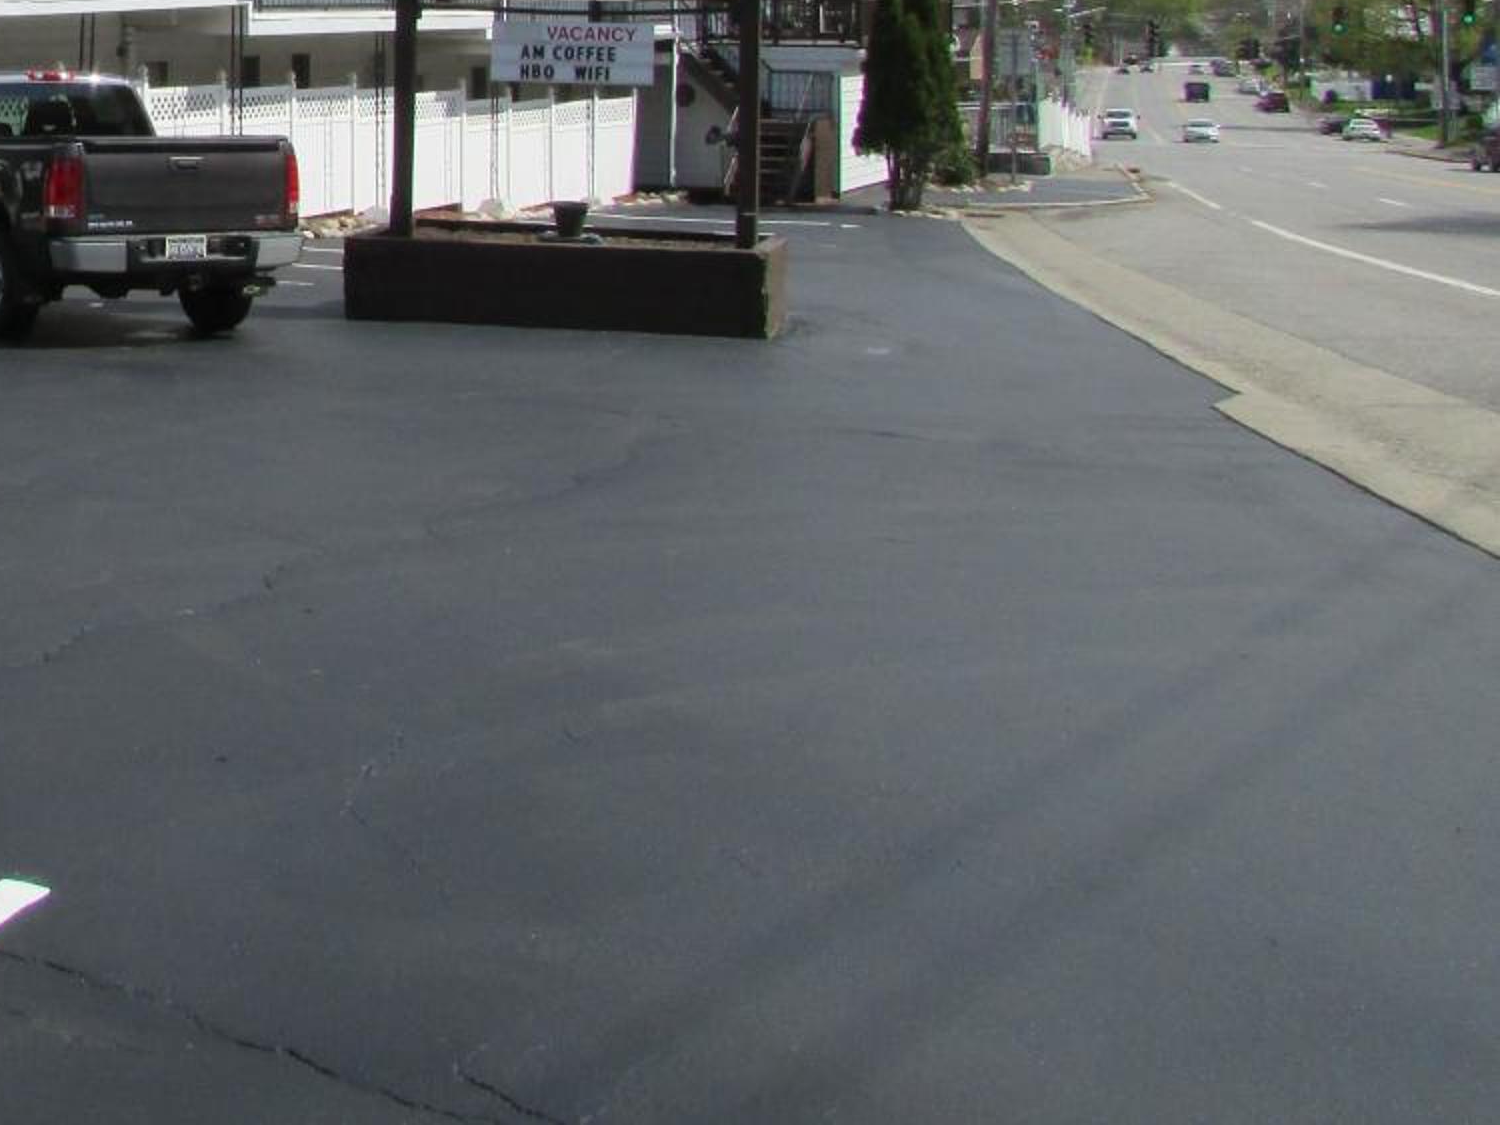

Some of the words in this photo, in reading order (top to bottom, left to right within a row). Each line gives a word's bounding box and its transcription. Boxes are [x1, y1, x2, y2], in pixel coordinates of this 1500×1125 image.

[547, 26, 637, 42] VACANCY
[520, 44, 545, 60] AM
[552, 46, 617, 62] COFFEE
[520, 64, 555, 79] HBO
[575, 66, 610, 81] WIFI
